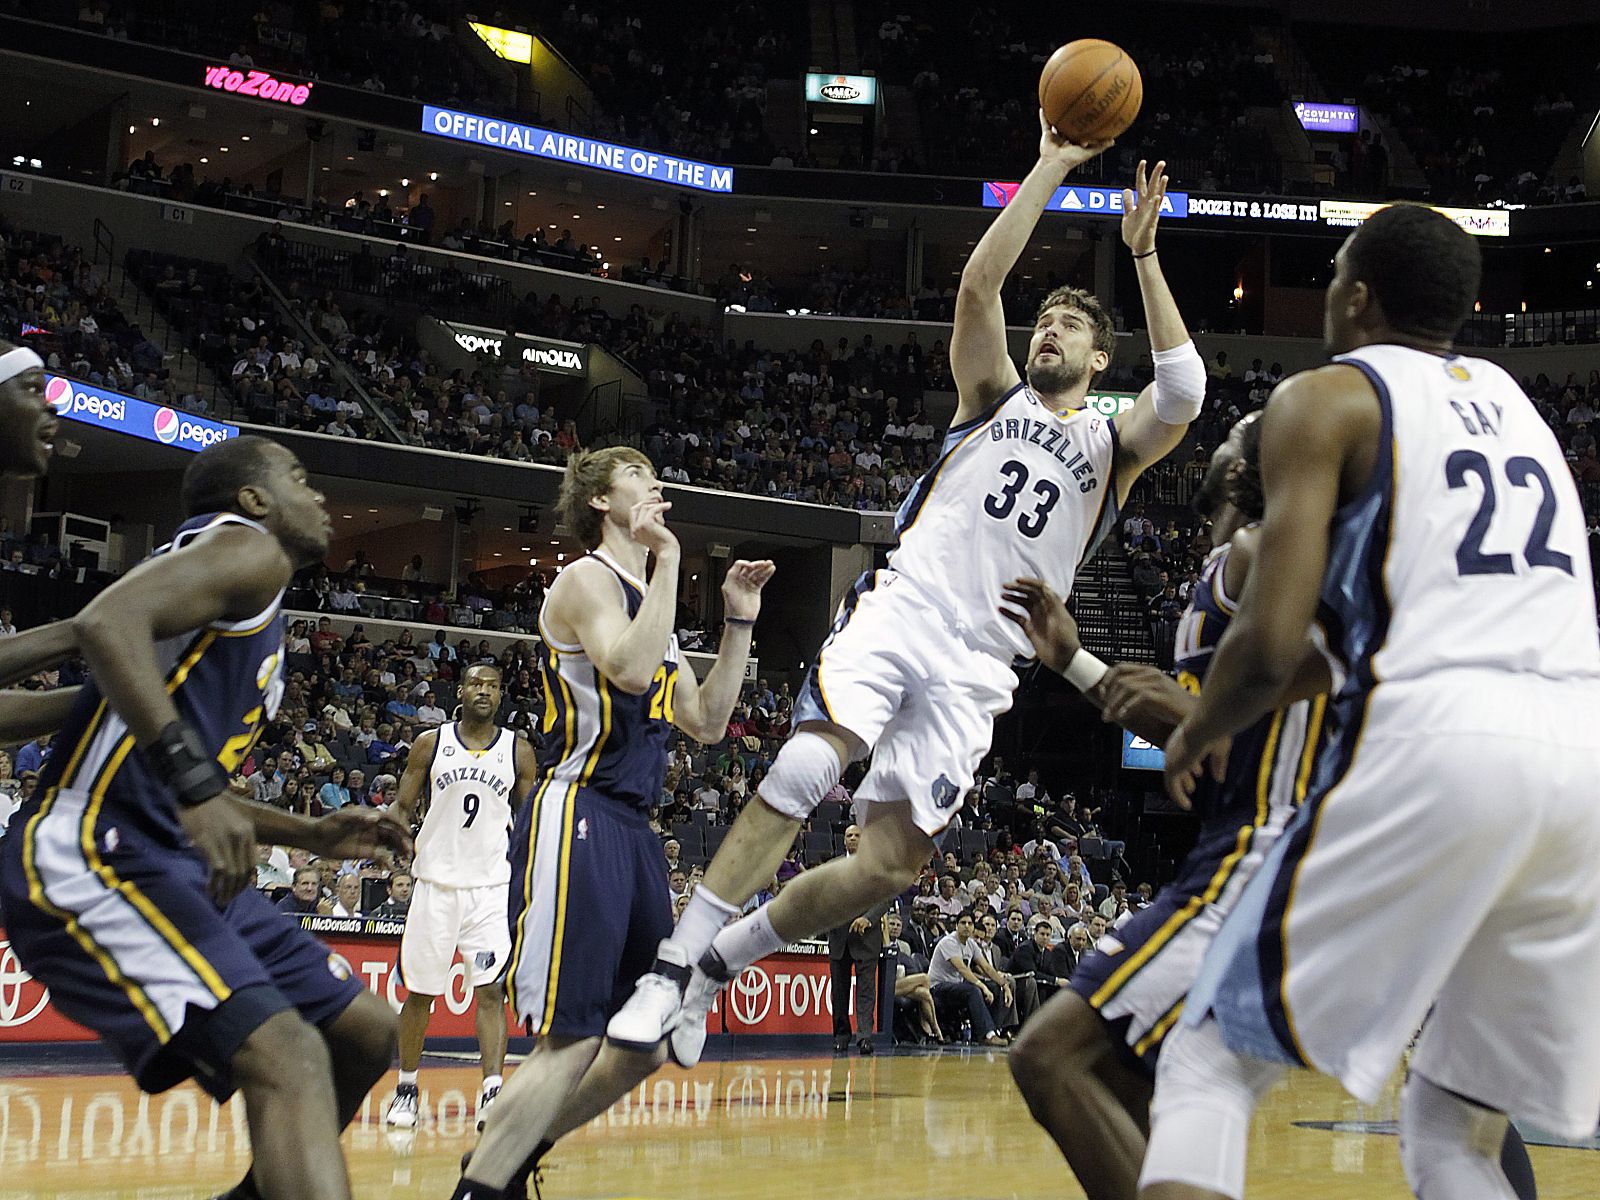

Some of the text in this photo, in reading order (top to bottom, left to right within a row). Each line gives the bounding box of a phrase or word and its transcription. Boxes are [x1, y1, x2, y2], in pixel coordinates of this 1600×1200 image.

[434, 112, 732, 189] OFFICIAL AIRLINE OF THE M
[10, 179, 24, 191] C2
[172, 208, 185, 220] C1
[1188, 199, 1318, 221] BOOZE IT & LOSE IT!
[73, 392, 228, 447] pepsi pepsi
[1450, 400, 1503, 436] GAY
[991, 418, 1098, 493] GRIZZLIES
[984, 460, 1060, 538] 33
[1445, 450, 1575, 577] 22
[436, 767, 508, 797] GRIZZLIES
[462, 794, 480, 828] 9
[311, 917, 361, 932] McDonald's
